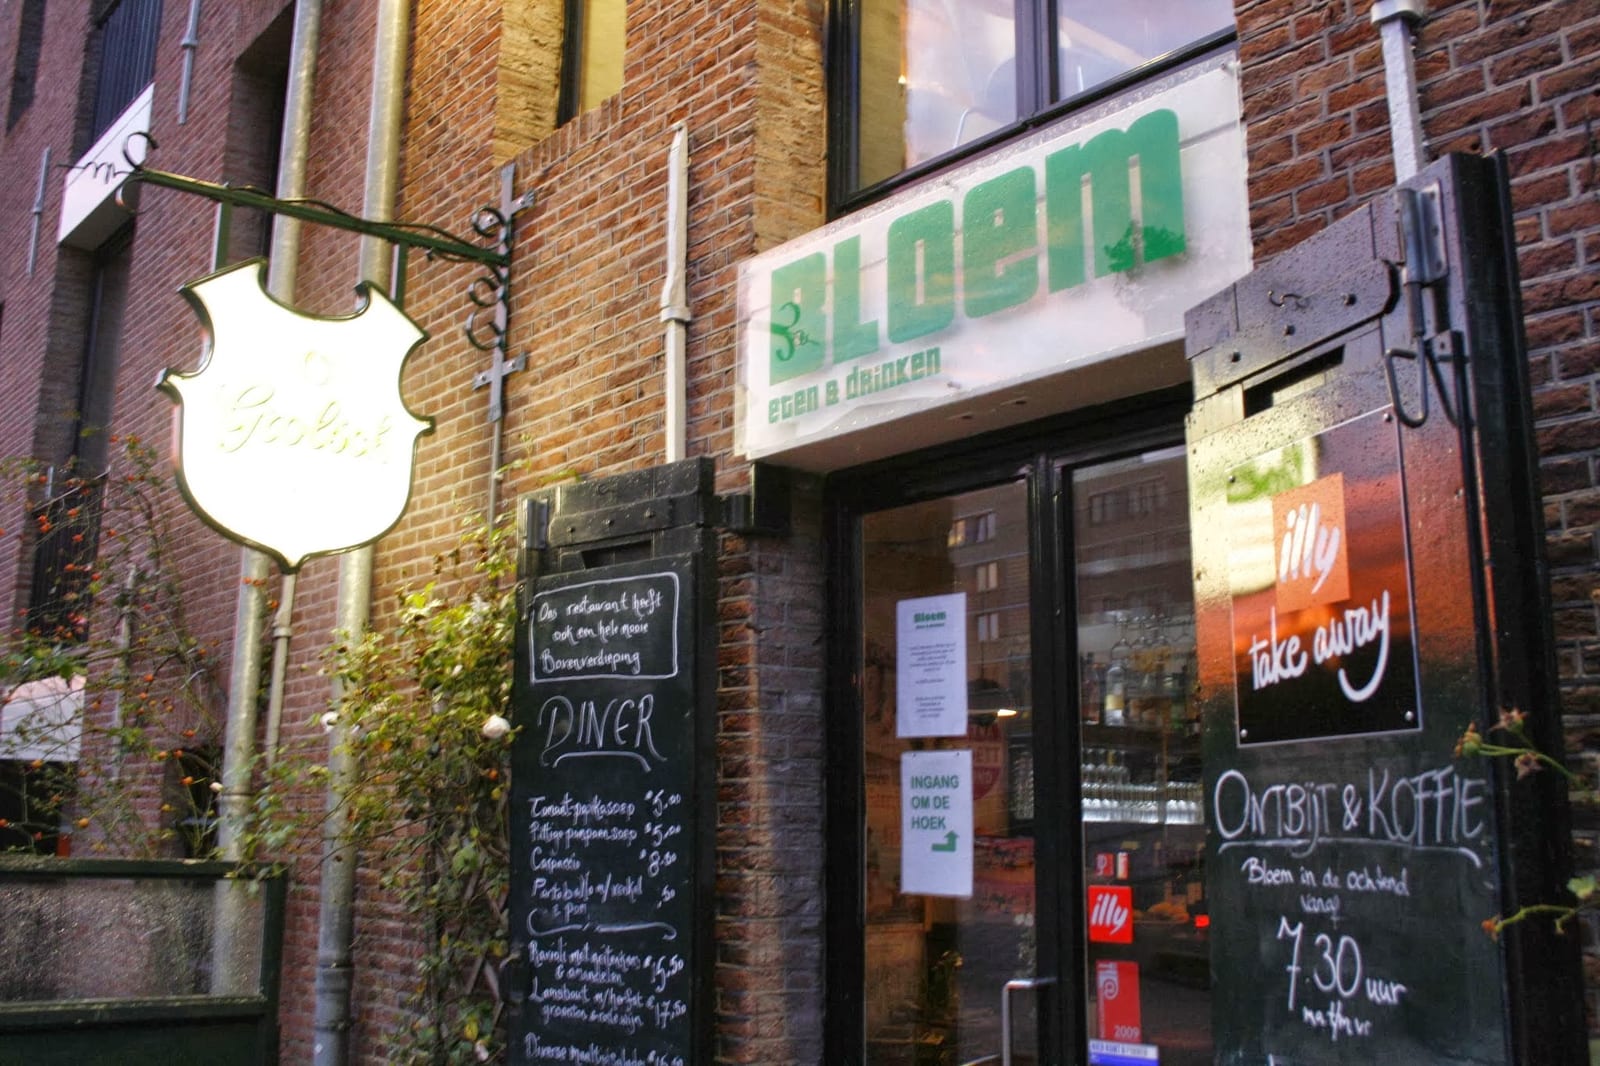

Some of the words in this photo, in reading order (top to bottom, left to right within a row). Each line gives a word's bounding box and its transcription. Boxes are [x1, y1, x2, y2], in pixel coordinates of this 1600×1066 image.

[768, 384, 819, 425] eten
[825, 379, 839, 406] &
[1279, 502, 1340, 594] illy
[537, 602, 557, 622] Ons
[566, 591, 629, 617] restaurant
[632, 588, 663, 618] heeft
[552, 624, 577, 646] ook
[576, 626, 597, 638] een
[1248, 605, 1308, 690] take
[1313, 589, 1390, 702] away
[537, 693, 668, 763] DINER
[911, 775, 960, 789] INGANG
[911, 796, 931, 810] OM
[933, 796, 950, 809] DE
[1341, 784, 1362, 831] &
[1369, 765, 1486, 846] KOFFIE
[911, 816, 947, 830] HOEK
[1241, 856, 1294, 885] Bloem
[1300, 865, 1315, 888] in
[1321, 867, 1340, 889] de
[1346, 864, 1410, 896] ochtend
[1091, 893, 1128, 935] illy
[1366, 977, 1407, 1005] uur
[1303, 1006, 1325, 1027] ma
